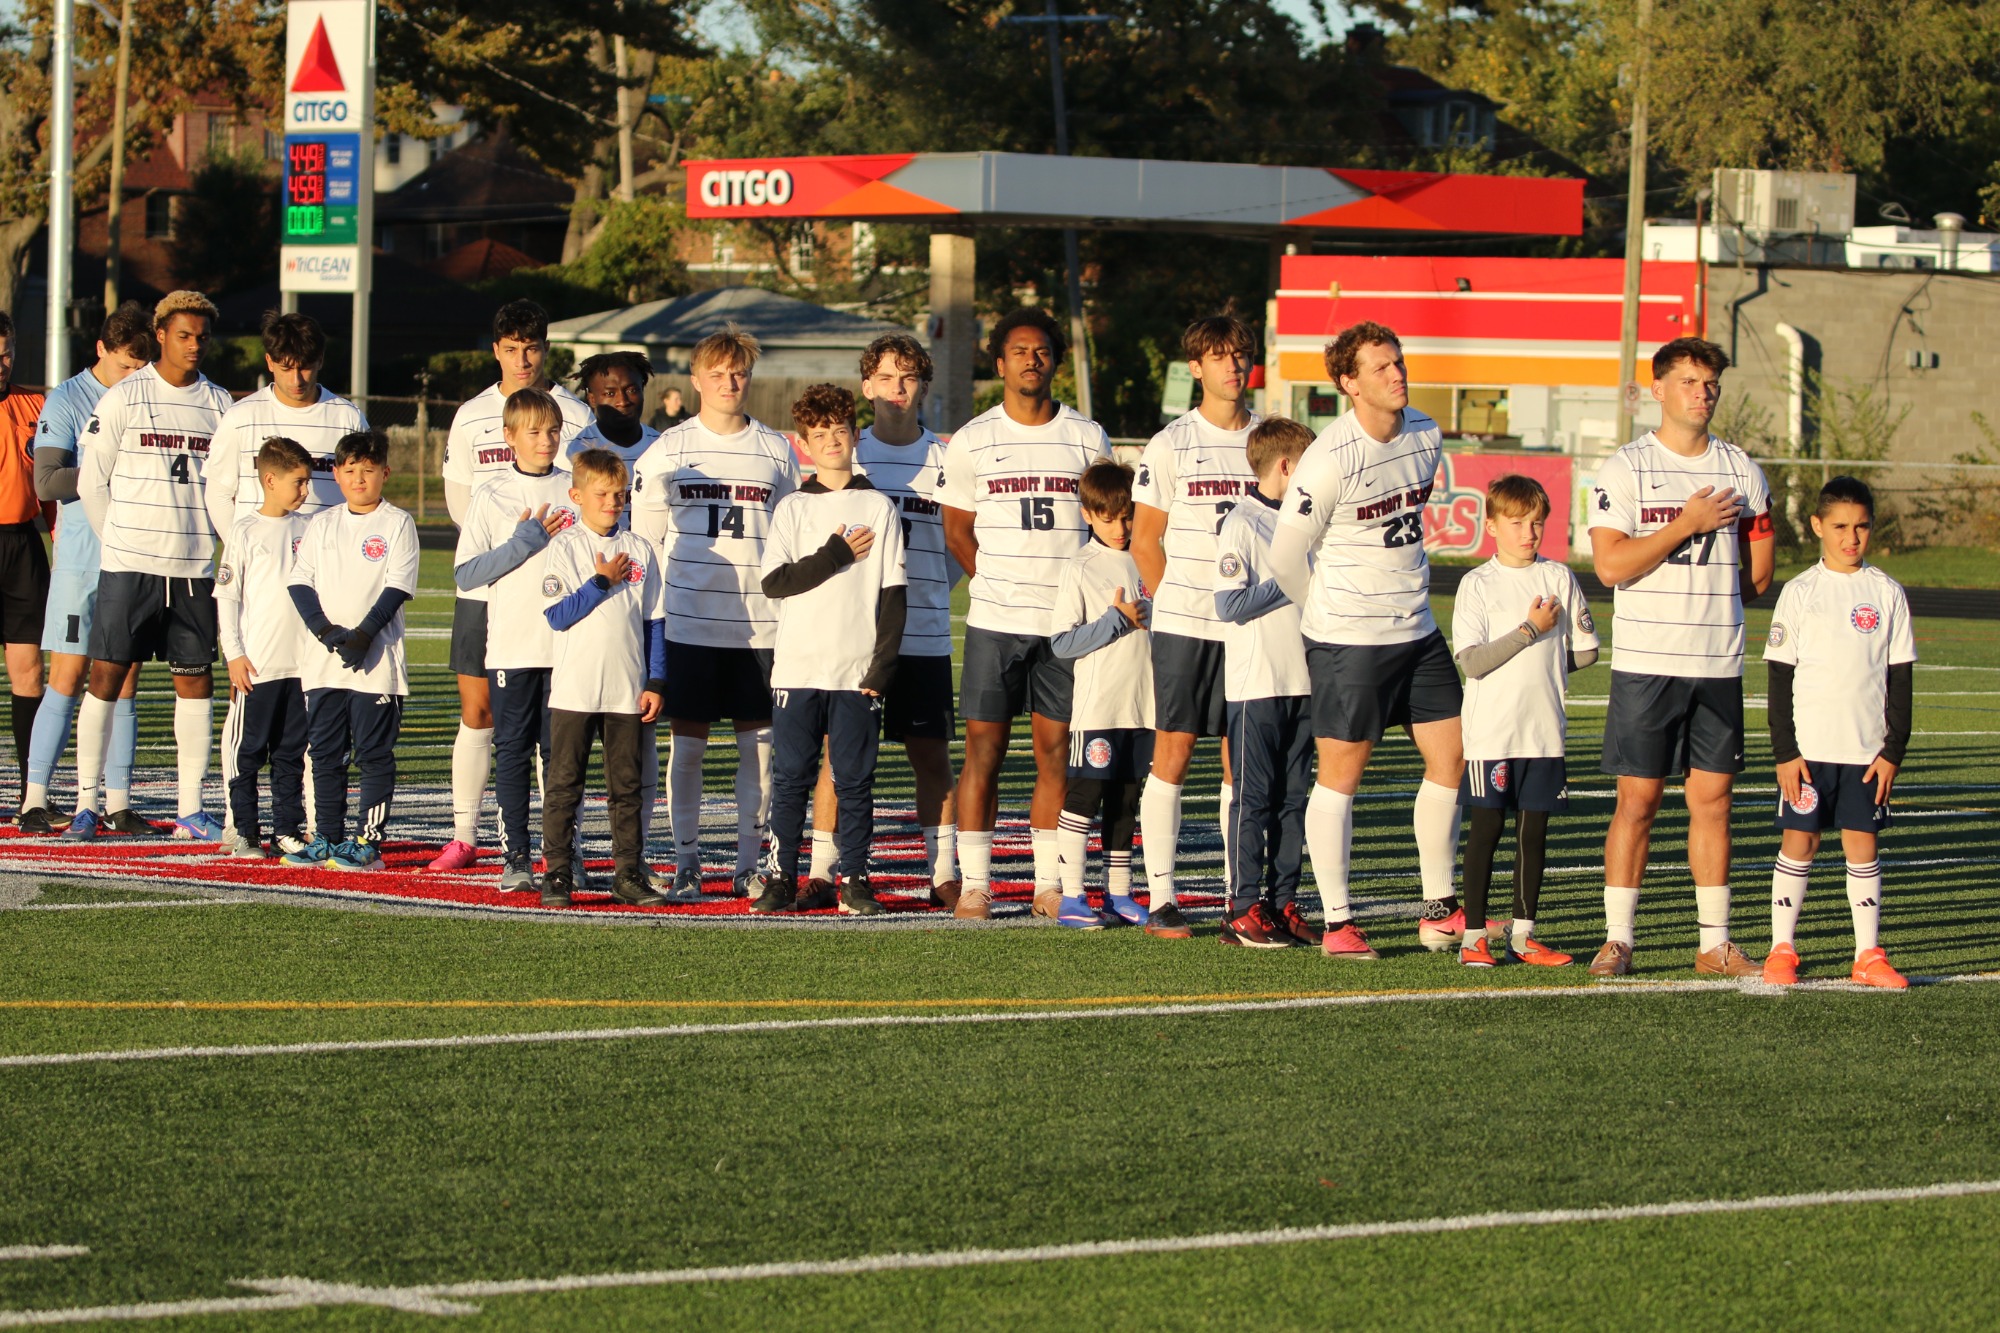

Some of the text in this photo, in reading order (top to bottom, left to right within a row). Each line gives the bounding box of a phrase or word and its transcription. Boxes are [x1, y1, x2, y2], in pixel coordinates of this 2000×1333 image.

[293, 101, 347, 121] CITGO
[701, 169, 793, 207] CITGO
[140, 433, 185, 449] DETROIT
[170, 454, 189, 484] 4
[679, 484, 772, 503] DETROIT MERCY
[986, 476, 1040, 494] DETROIT
[1187, 480, 1240, 496] DETROIT
[1020, 497, 1054, 531] 15
[1357, 493, 1402, 520] DETROIT
[707, 504, 744, 539] 14
[1381, 512, 1423, 548] 23
[65, 614, 80, 643] 1
[497, 670, 506, 687] 8
[776, 689, 789, 708] 17
